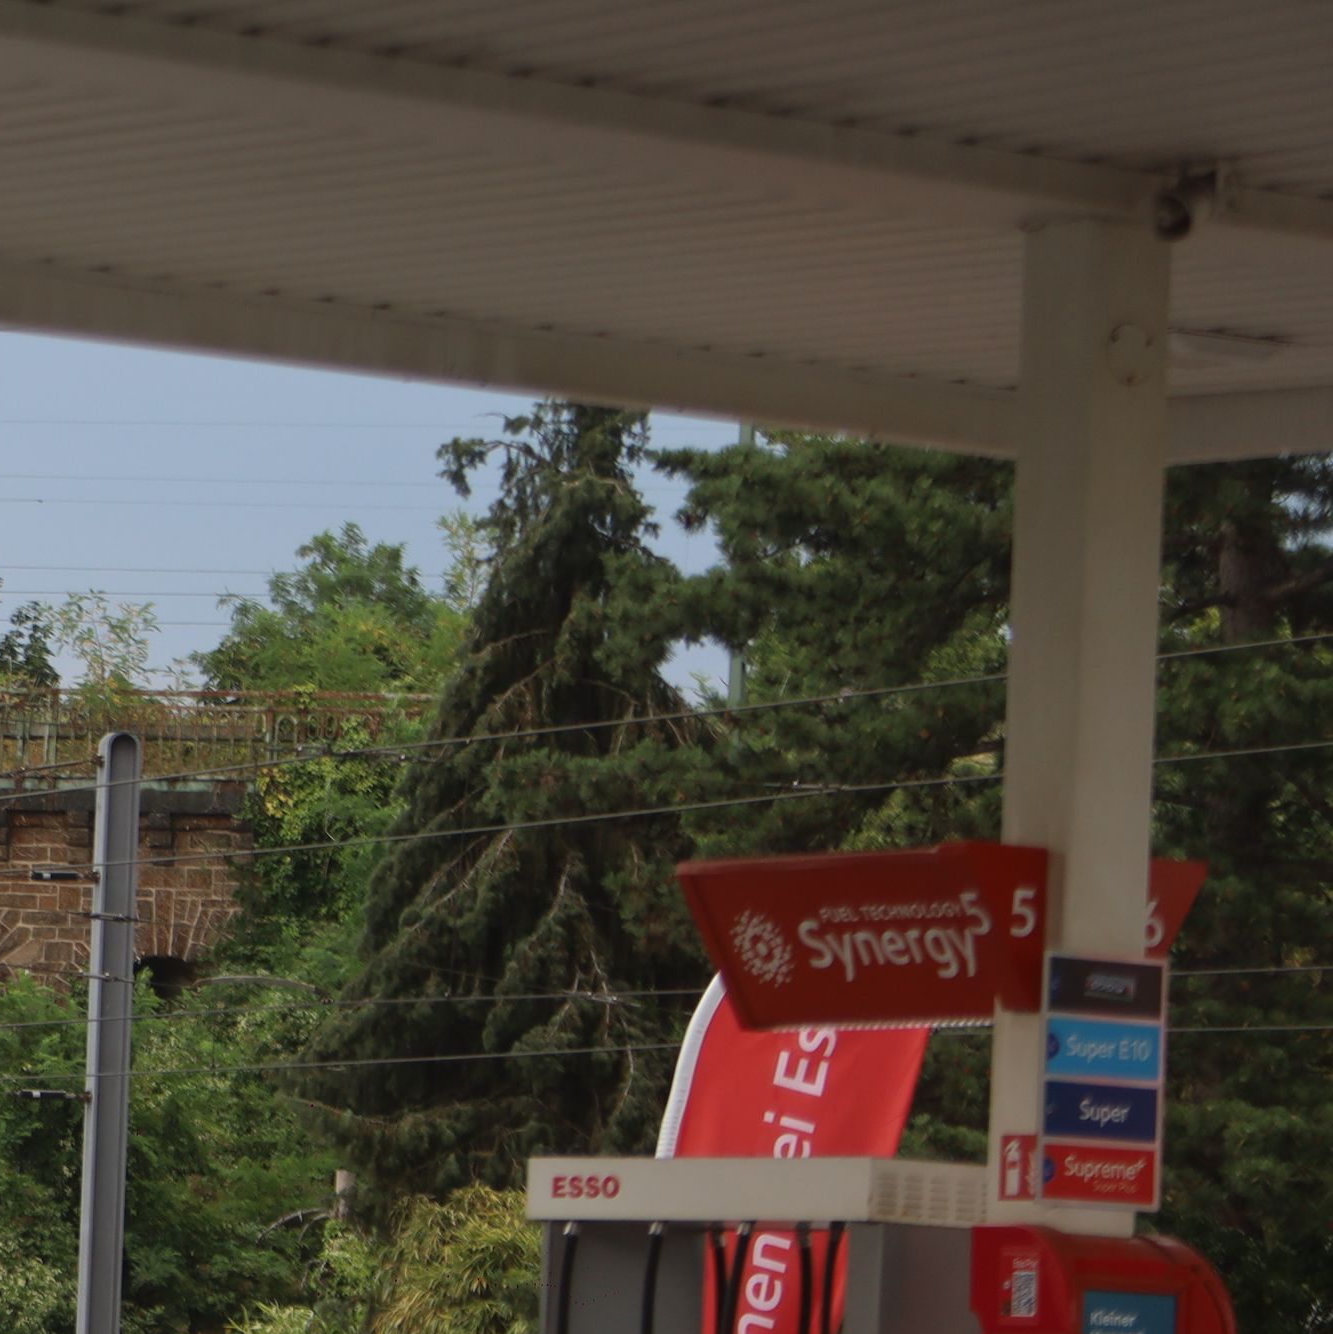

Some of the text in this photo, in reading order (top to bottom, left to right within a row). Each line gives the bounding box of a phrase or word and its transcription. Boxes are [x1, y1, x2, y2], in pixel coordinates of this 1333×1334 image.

[819, 905, 860, 923] FUEL
[960, 892, 992, 936] 5
[1010, 889, 1036, 937] 5
[798, 918, 978, 982] Synergy
[1066, 1034, 1150, 1063] Super E10
[1079, 1097, 1131, 1128] Super
[552, 1175, 621, 1199] ESSO
[1089, 1311, 1137, 1328] Kleiner
